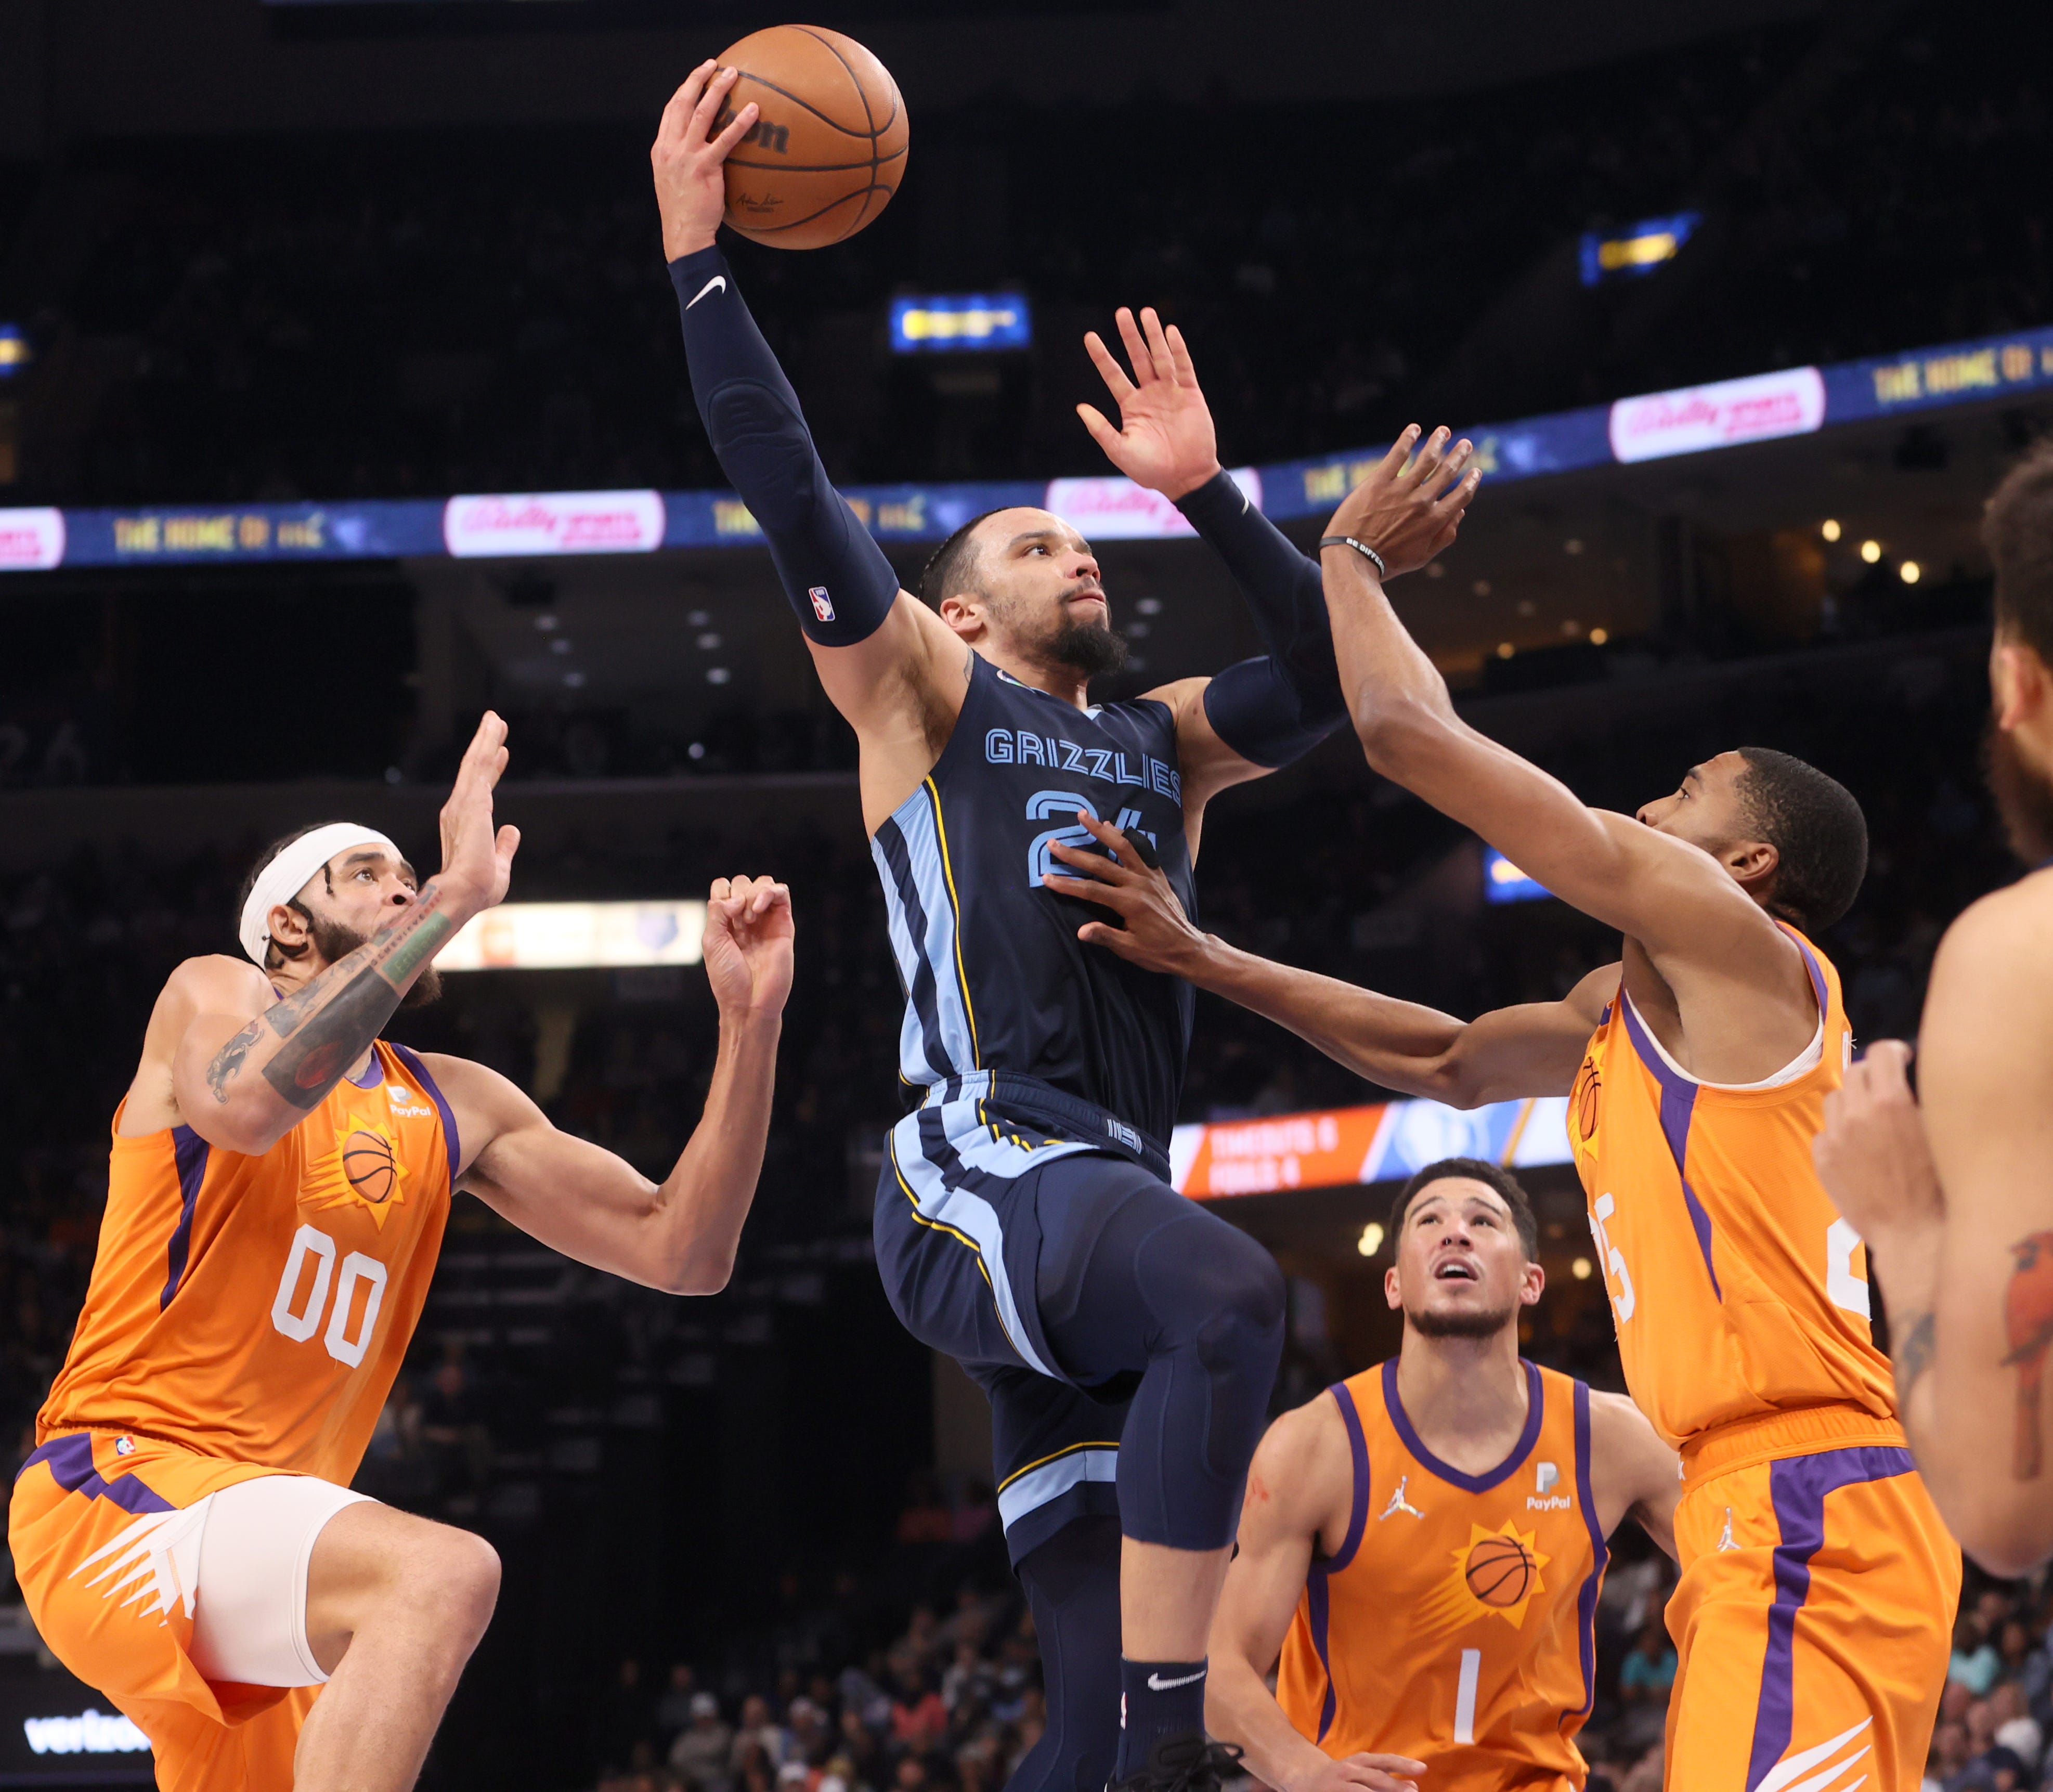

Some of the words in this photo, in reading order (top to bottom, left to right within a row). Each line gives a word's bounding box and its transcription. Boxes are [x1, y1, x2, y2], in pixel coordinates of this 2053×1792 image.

[985, 728, 1181, 809] GRIZZLIES
[389, 1104, 431, 1118] PayPal
[271, 1223, 387, 1369] 00
[1527, 1496, 1570, 1511] PayPal
[1454, 1648, 1481, 1745] 1
